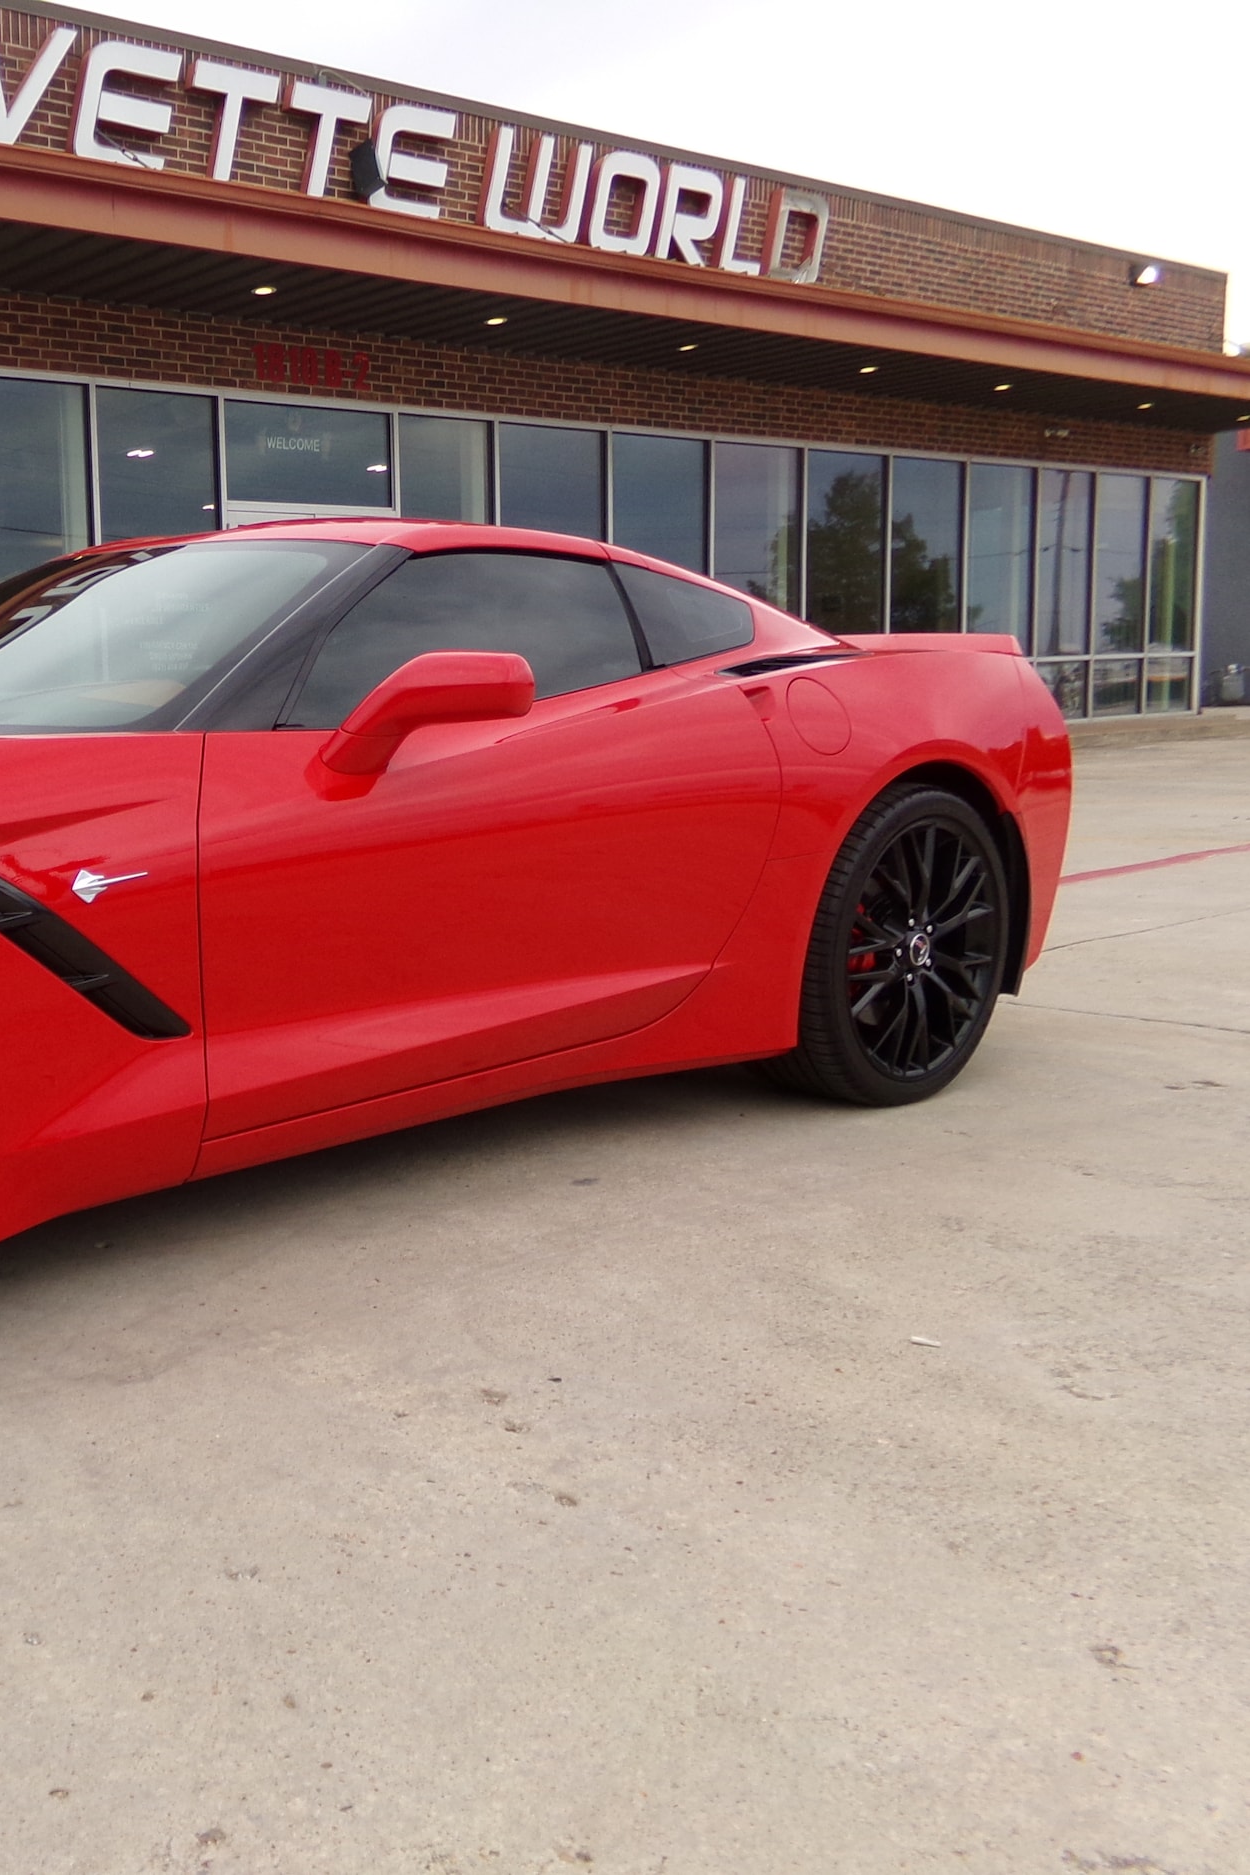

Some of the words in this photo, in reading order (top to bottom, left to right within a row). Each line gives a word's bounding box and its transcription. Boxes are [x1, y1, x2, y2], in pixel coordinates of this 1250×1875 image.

[483, 126, 829, 284] WORLD
[252, 343, 319, 386] 1810
[267, 437, 321, 452] WELCOME
